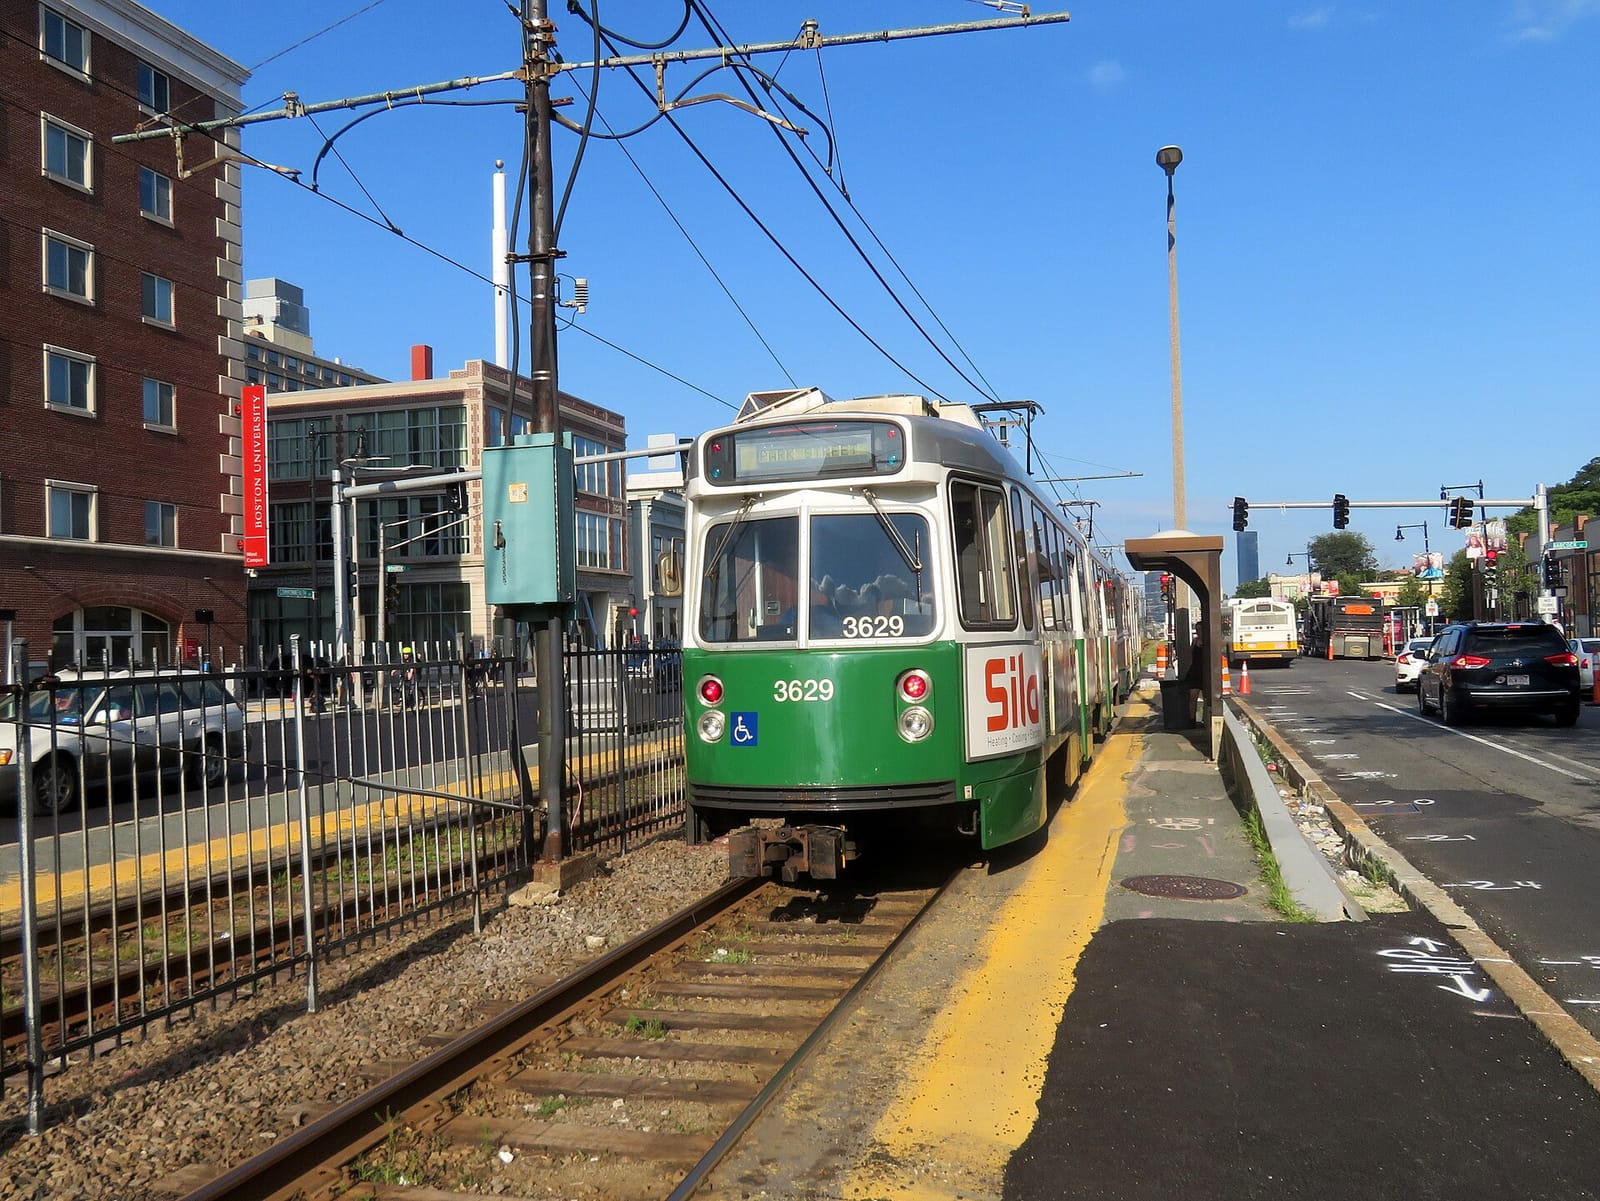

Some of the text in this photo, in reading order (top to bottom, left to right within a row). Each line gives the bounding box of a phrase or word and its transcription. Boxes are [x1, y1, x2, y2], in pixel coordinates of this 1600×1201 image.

[253, 395, 263, 528] BOSTON UNIVERSITY
[842, 615, 904, 638] 3629
[773, 678, 834, 702] 3629
[987, 734, 1008, 749] Heating
